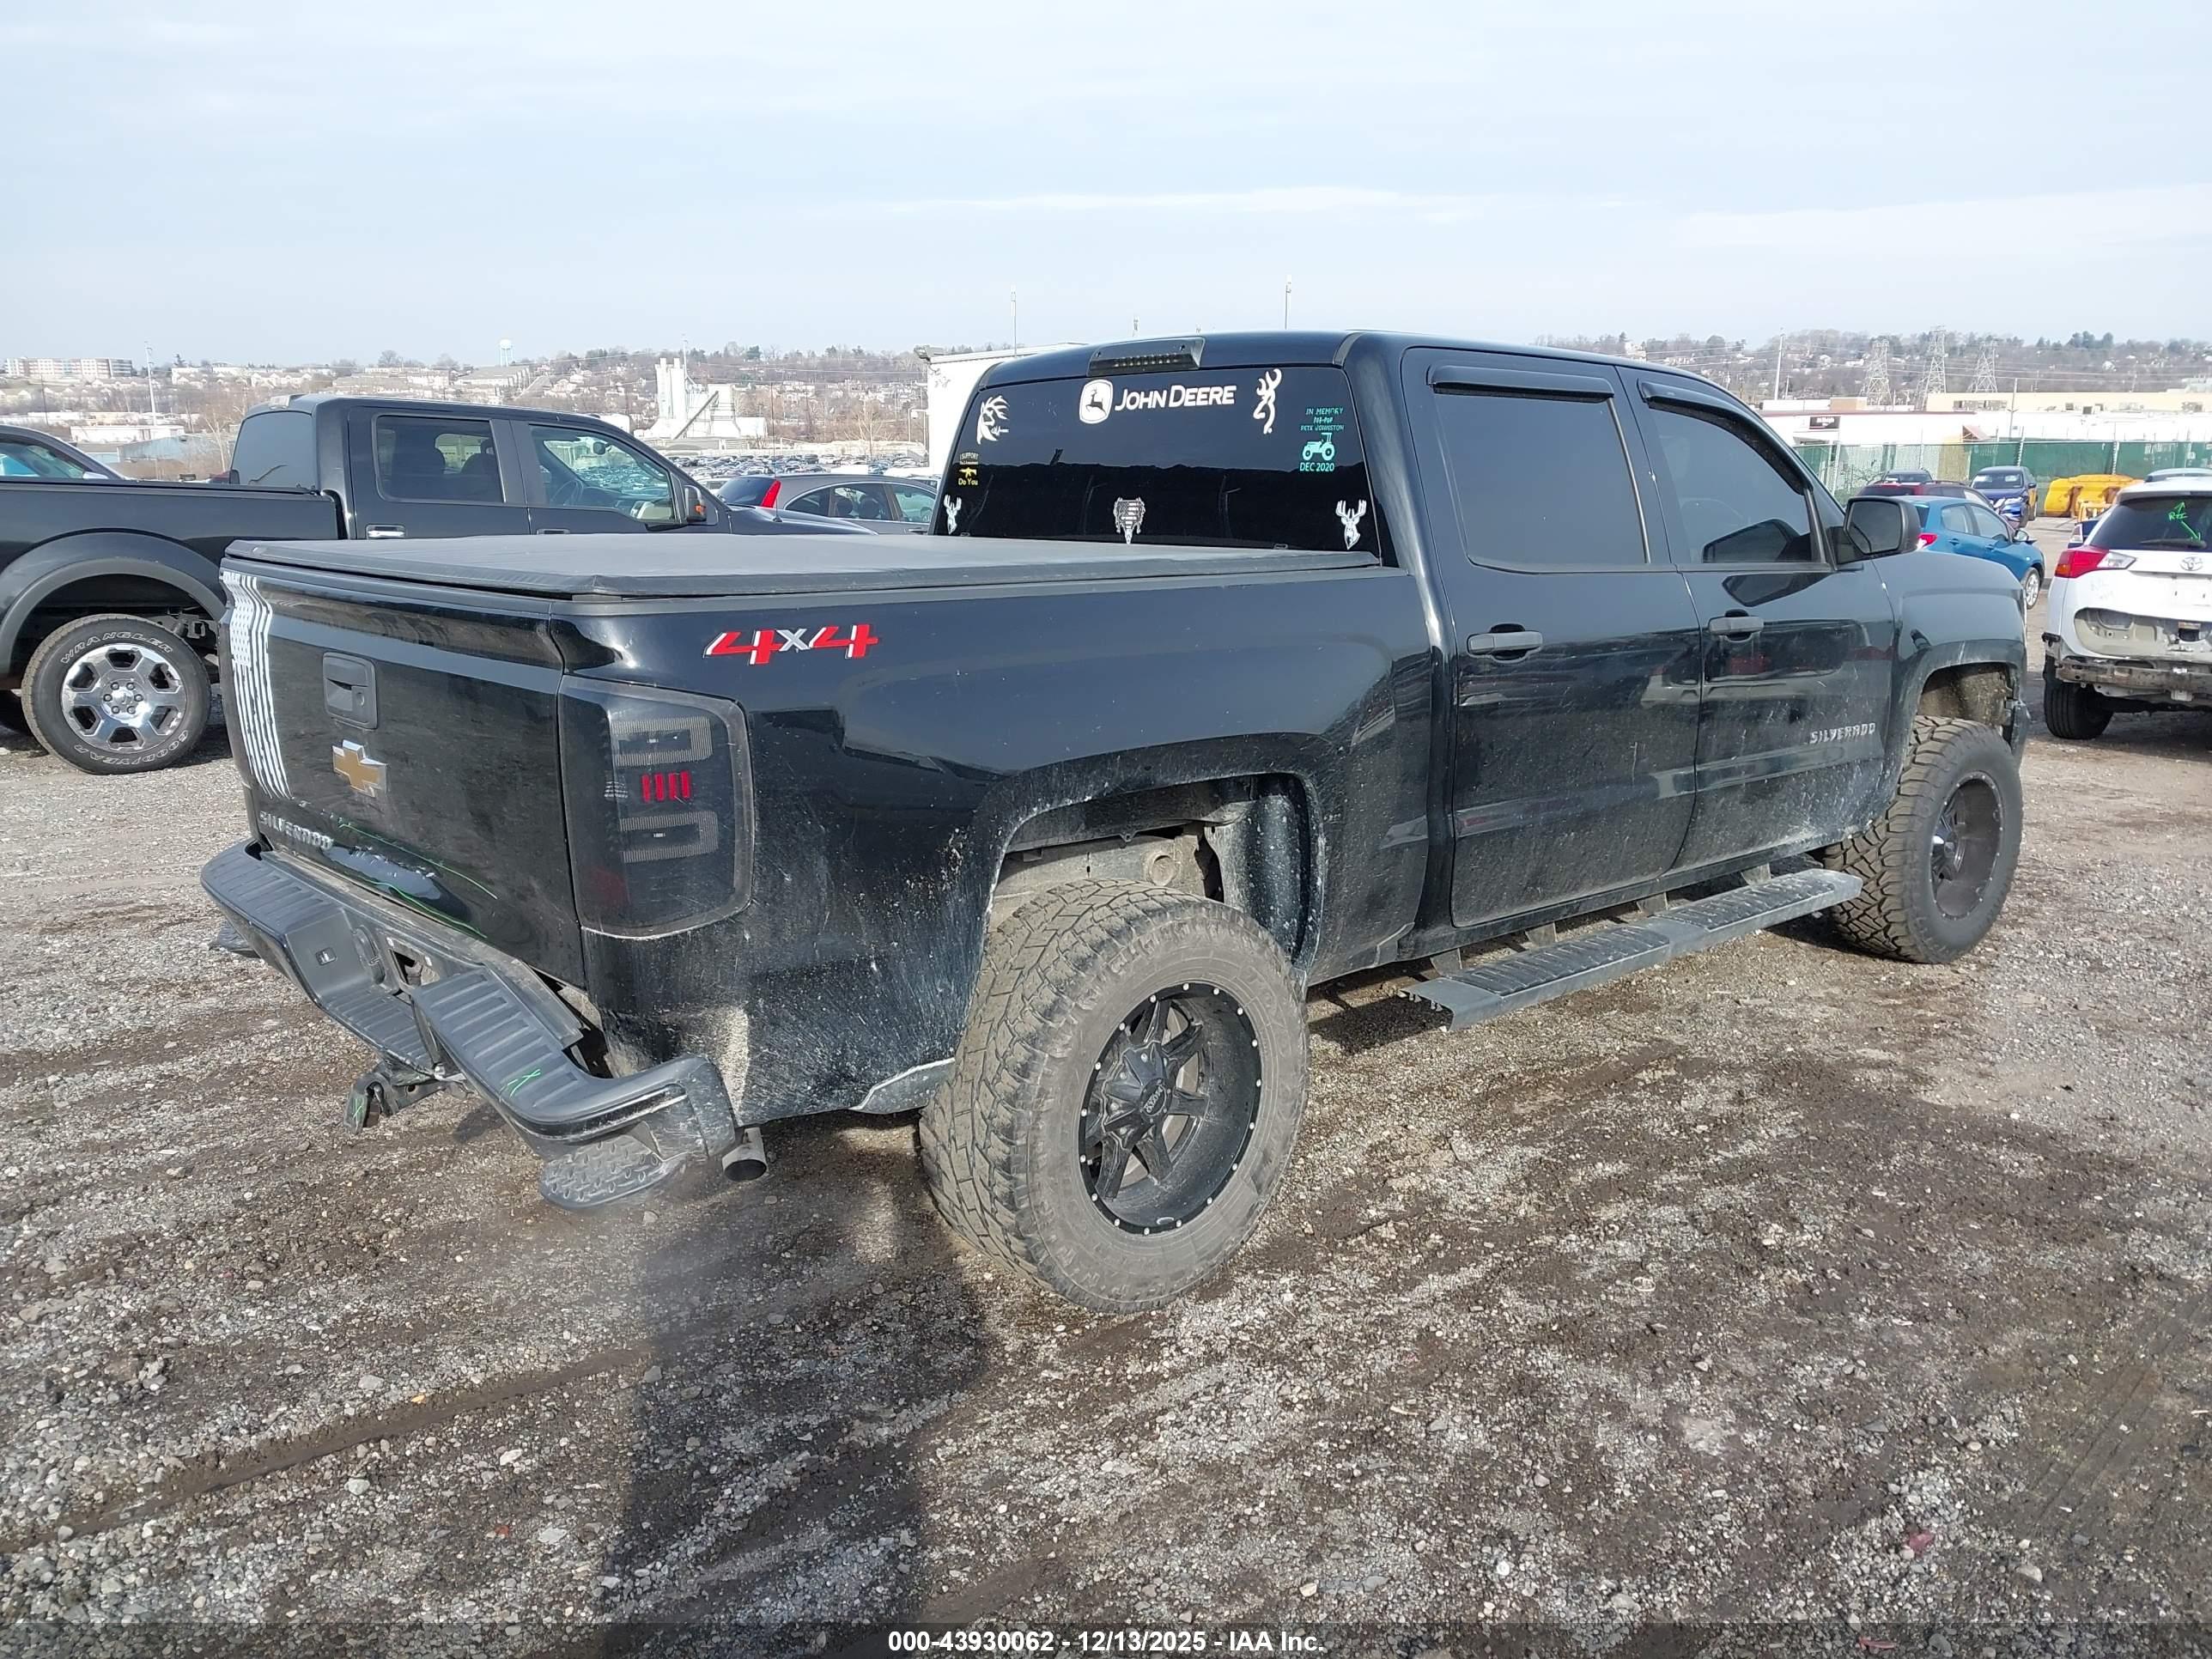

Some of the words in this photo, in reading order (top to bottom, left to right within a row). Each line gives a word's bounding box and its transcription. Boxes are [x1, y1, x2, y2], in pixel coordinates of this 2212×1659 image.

[1115, 389, 1167, 410] JOHN
[1169, 385, 1237, 407] DEERE
[1299, 462, 1316, 471] DEC
[1316, 462, 1335, 472] 2020
[958, 477, 967, 486] Do
[967, 477, 978, 486] You
[60, 631, 173, 664] WRANGLER
[1809, 722, 1876, 744] SILVERADO
[259, 810, 334, 851] SILVERADO
